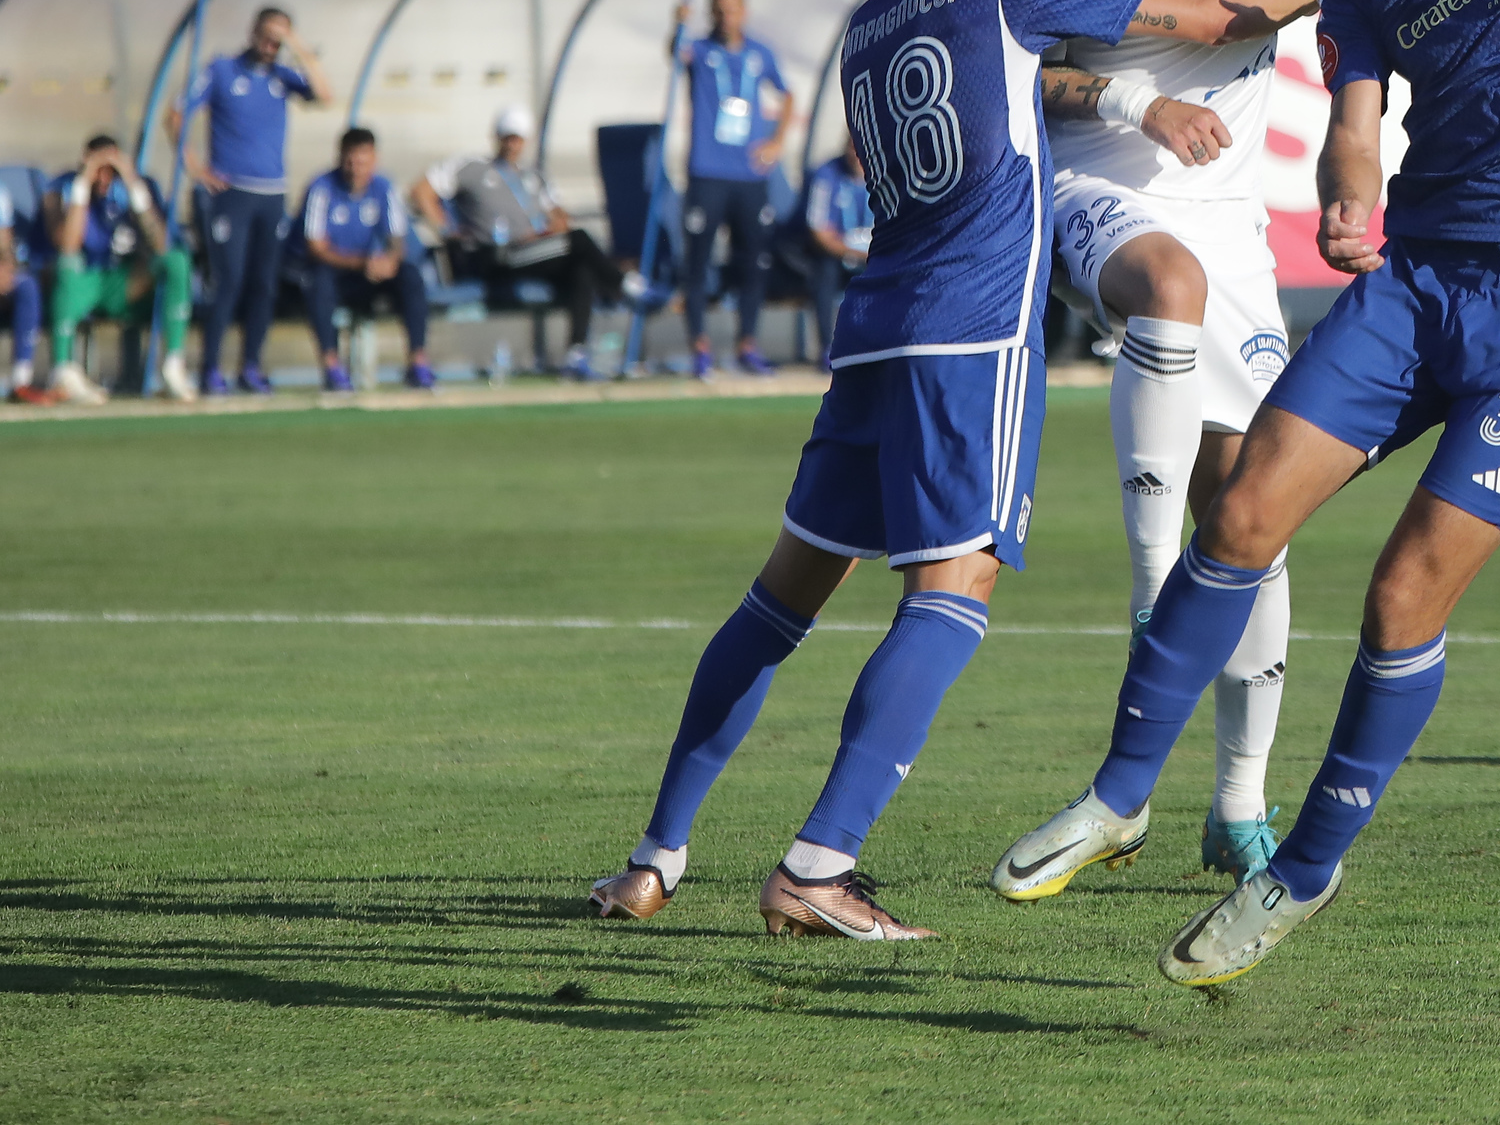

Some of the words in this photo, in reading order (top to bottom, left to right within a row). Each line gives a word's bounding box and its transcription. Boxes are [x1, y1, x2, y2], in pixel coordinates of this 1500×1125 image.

[851, 35, 964, 221] 18
[1067, 196, 1127, 251] 32
[1123, 481, 1171, 496] adidas
